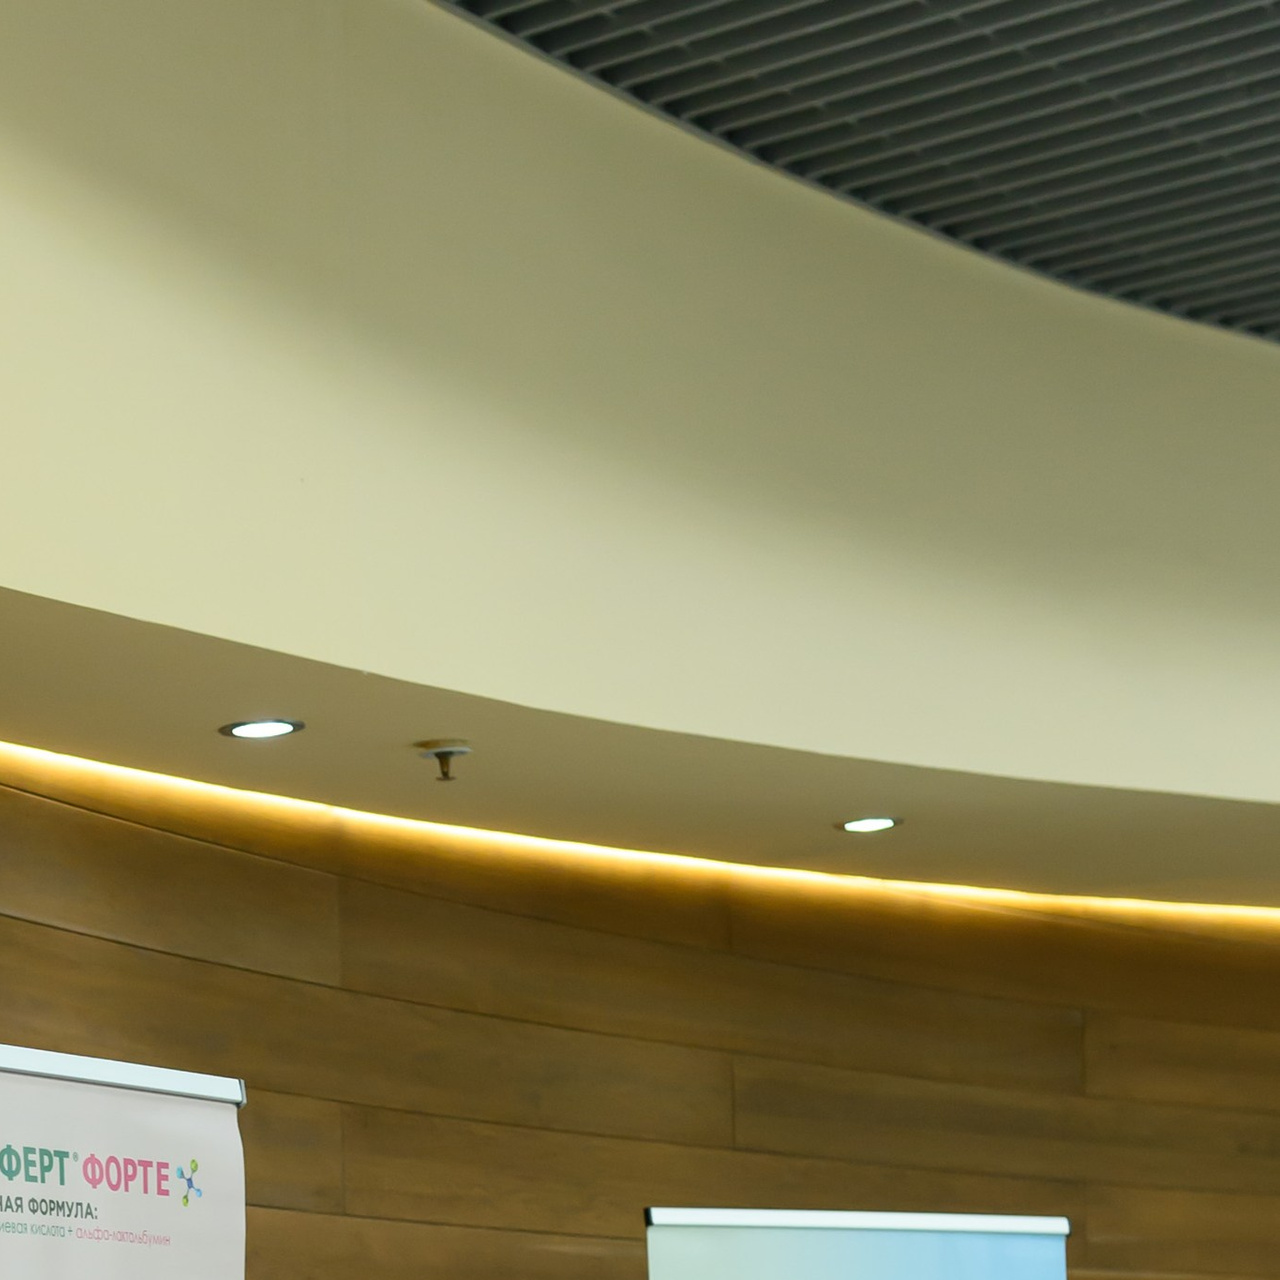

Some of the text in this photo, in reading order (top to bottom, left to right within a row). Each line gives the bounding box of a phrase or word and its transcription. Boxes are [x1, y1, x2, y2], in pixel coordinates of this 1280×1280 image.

[82, 1153, 170, 1196] ФОРТЕ
[28, 1198, 98, 1220] ФОРМУЛА:
[30, 1224, 66, 1238] кислота
